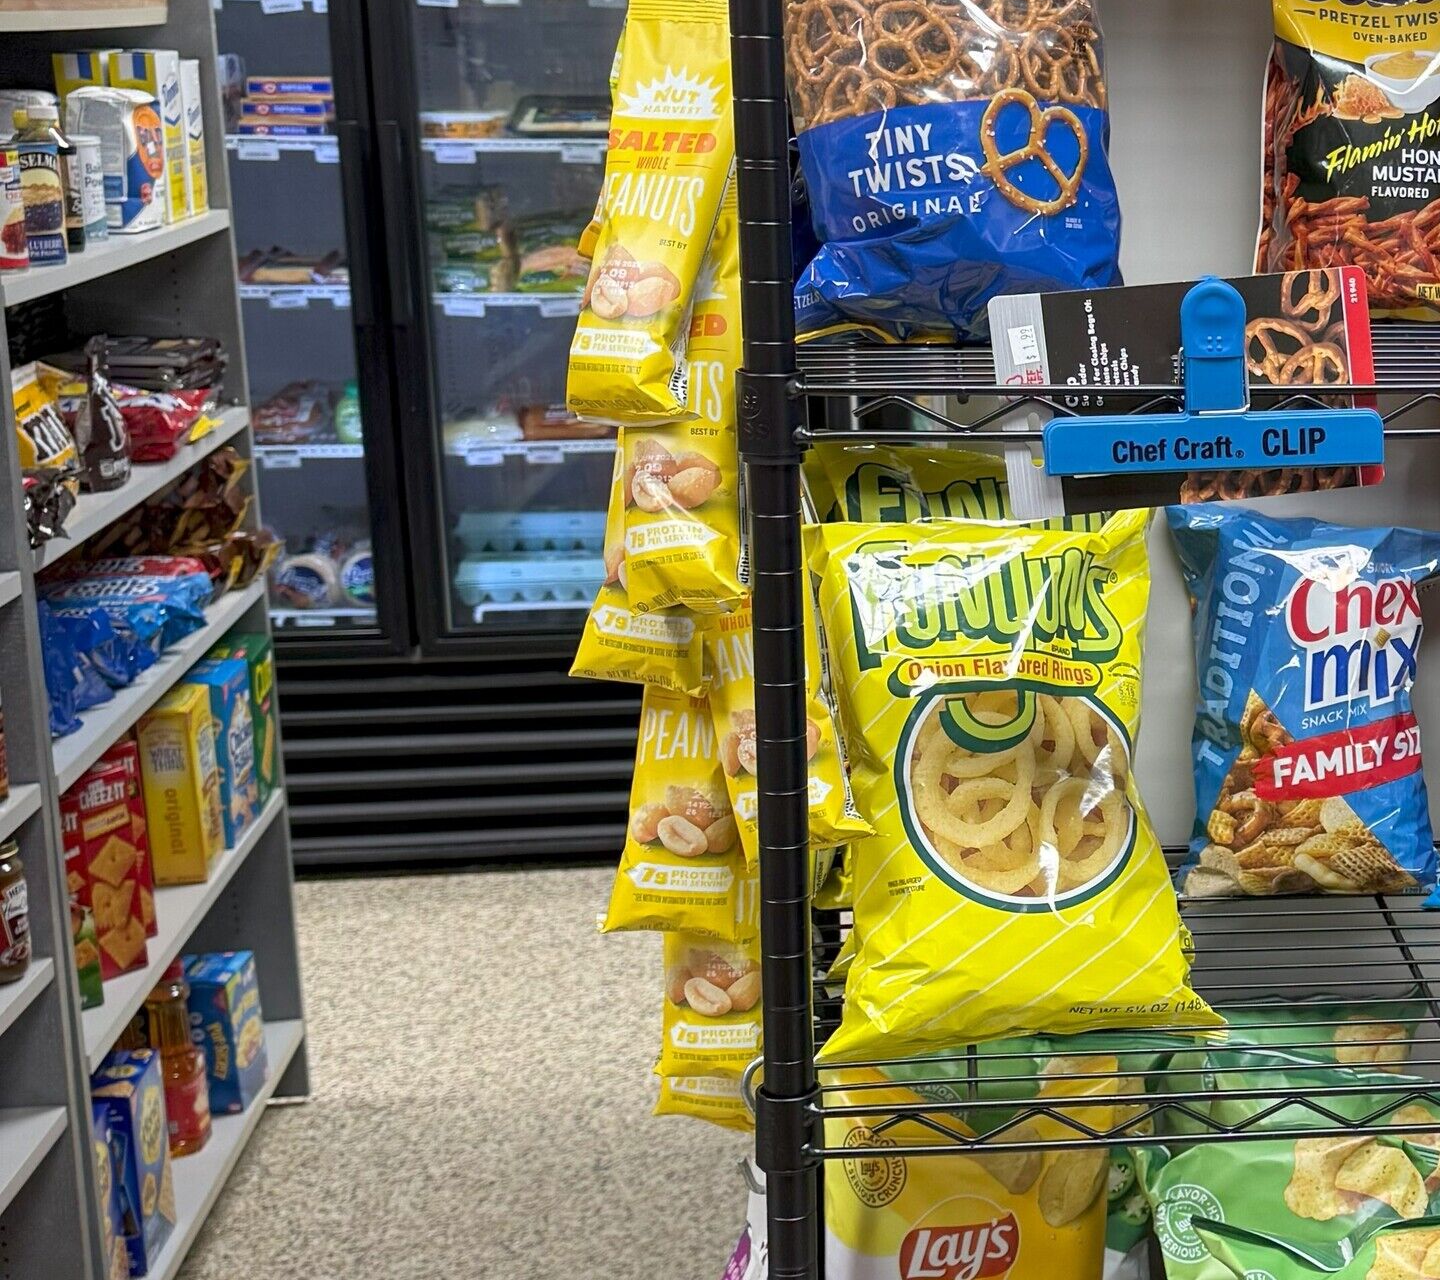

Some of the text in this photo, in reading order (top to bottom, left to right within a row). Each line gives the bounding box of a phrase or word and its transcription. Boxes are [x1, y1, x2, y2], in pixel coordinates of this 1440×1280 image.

[1318, 8, 1391, 29] PRETZEL
[1353, 31, 1428, 44] OVEN-BAKED
[653, 87, 701, 104] NUT
[643, 104, 702, 114] HARVEST
[608, 129, 717, 154] SALTED
[865, 123, 933, 160] TINY
[636, 156, 670, 171] WHOLE
[848, 154, 966, 199] TWISTS
[608, 172, 705, 238] EANUTS
[1371, 185, 1430, 199] FLAVORED
[852, 190, 981, 233] ORIGINAL
[594, 333, 645, 346] PROTEIN
[690, 428, 707, 436] BEST
[1112, 428, 1327, 465] Chef Craft CLIP
[1289, 576, 1422, 643] Chex
[907, 658, 966, 681] Onion
[1052, 658, 1093, 684] Rings
[1310, 625, 1423, 706] mix
[1301, 703, 1368, 729] SNACK MIX
[1273, 732, 1389, 788] FAMILY
[165, 787, 187, 855] original
[671, 872, 729, 880] PROTEIN
